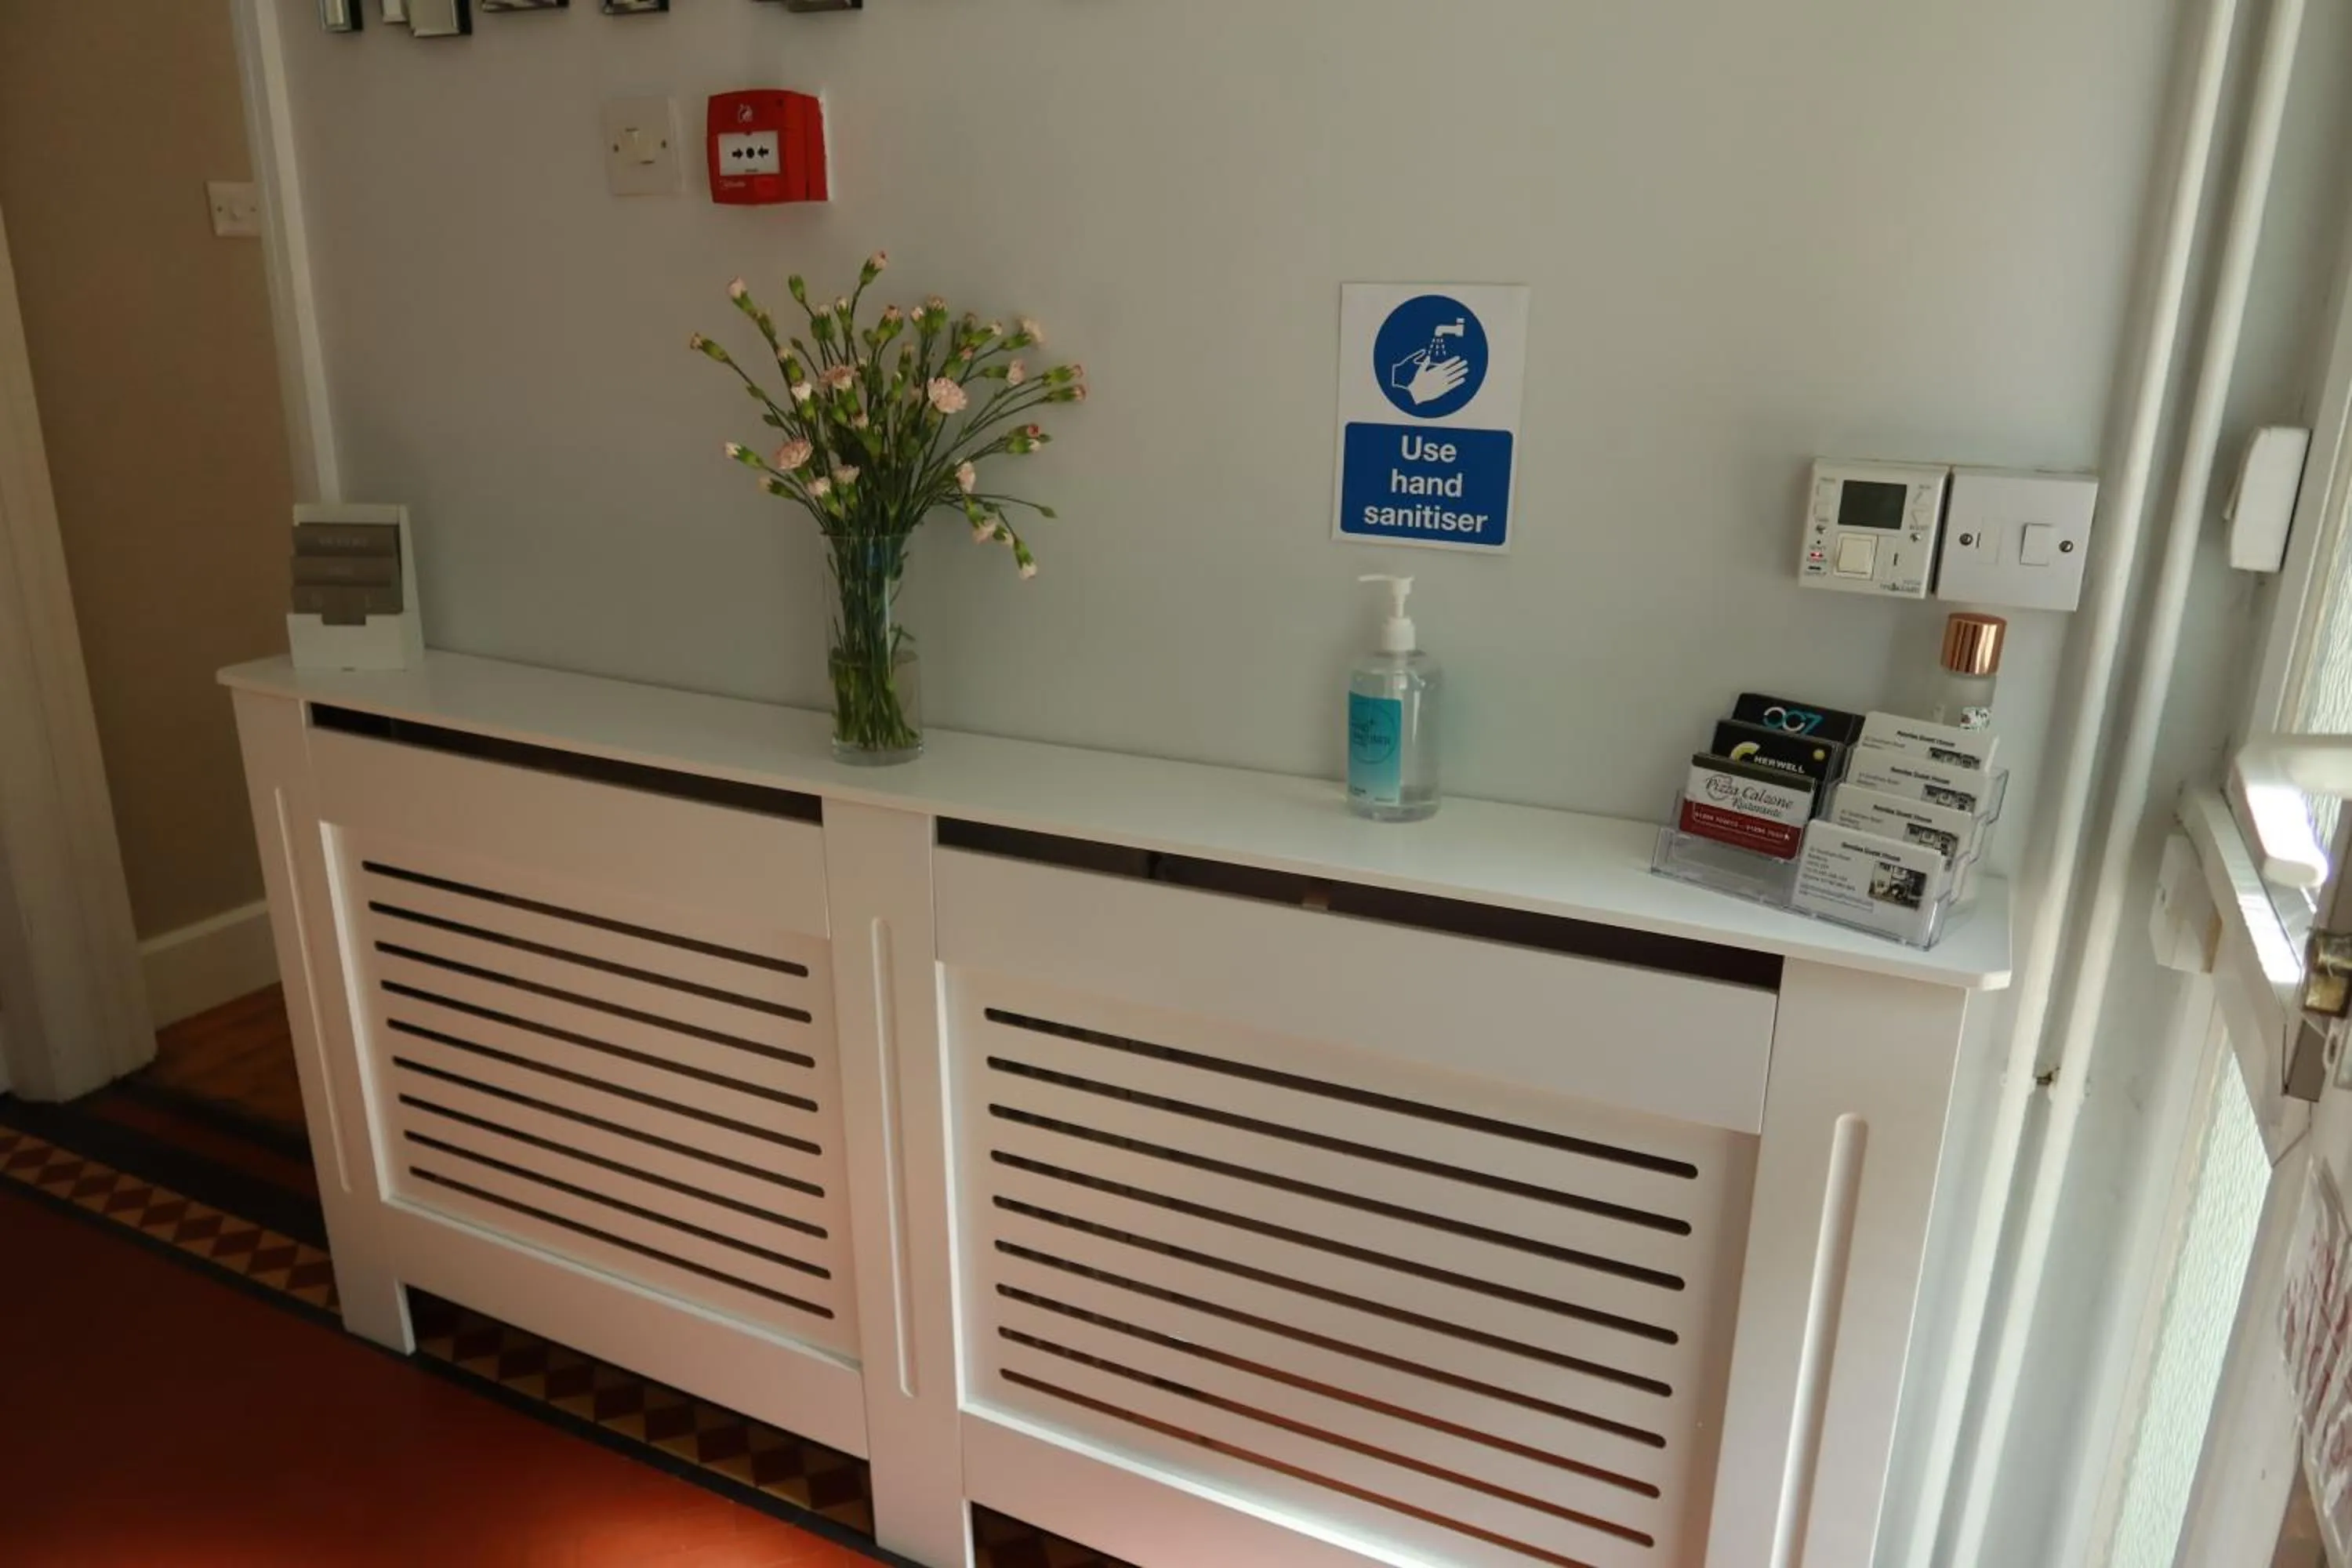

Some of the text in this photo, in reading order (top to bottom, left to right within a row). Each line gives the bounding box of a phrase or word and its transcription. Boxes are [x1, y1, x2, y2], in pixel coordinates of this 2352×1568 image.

[1401, 435, 1457, 463] Use
[1391, 468, 1464, 499] hand
[1363, 505, 1489, 534] sanitiser
[1705, 777, 1740, 796] Pizza
